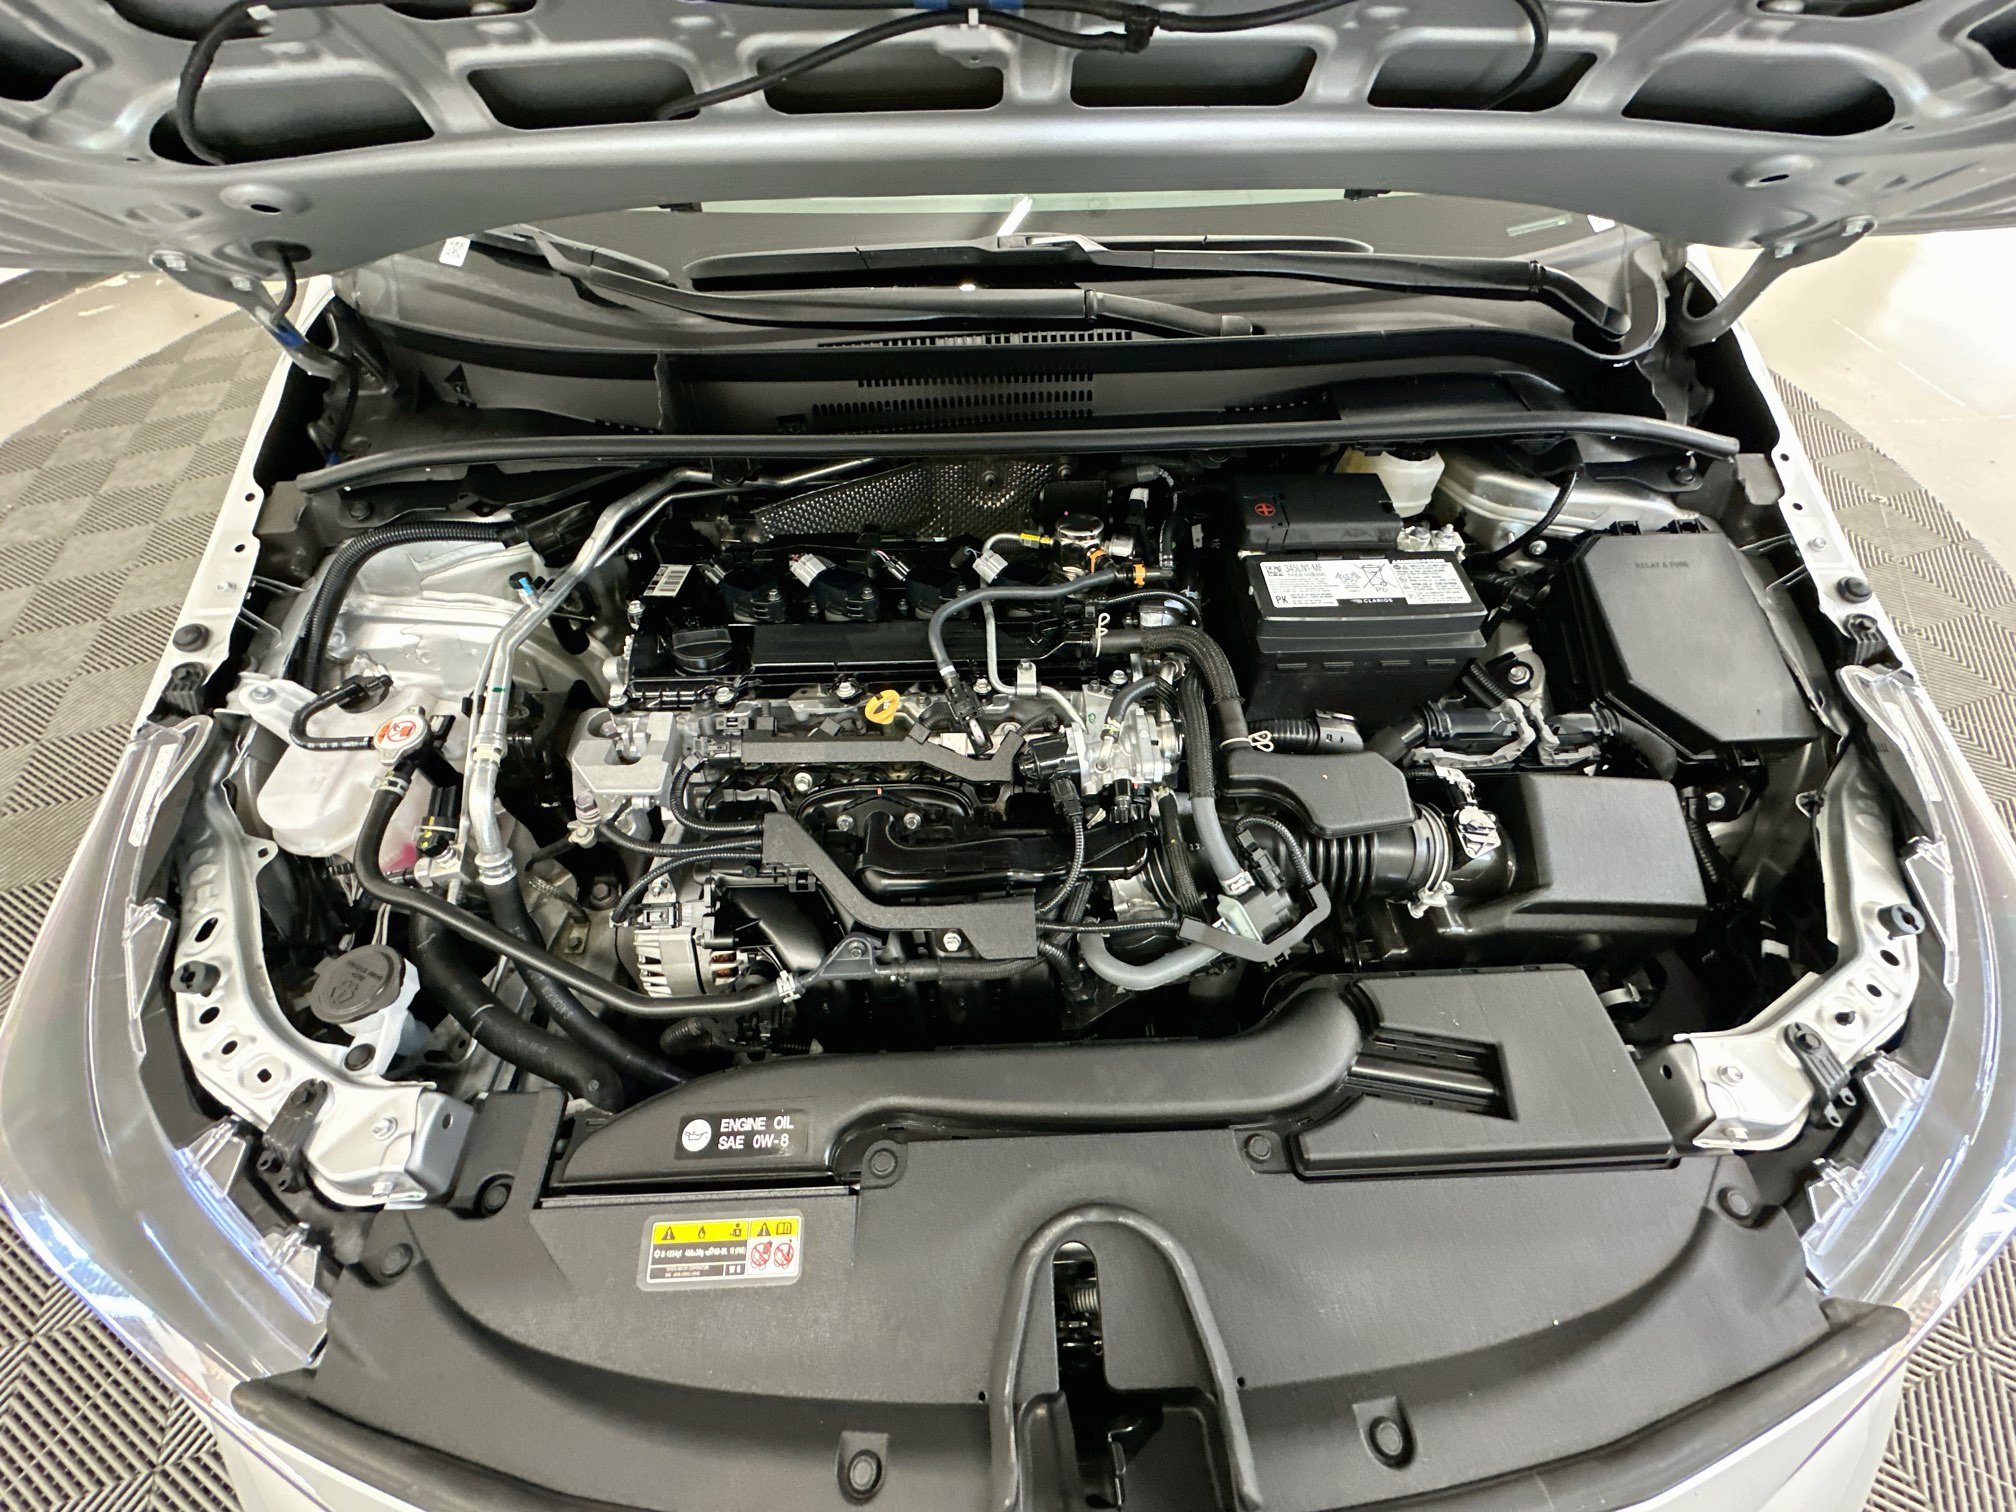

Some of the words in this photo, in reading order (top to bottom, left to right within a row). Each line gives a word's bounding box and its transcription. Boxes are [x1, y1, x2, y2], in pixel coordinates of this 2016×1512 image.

[1275, 595, 1289, 604] PK
[720, 1117, 766, 1132] ENGINE
[773, 1115, 794, 1129] OIL
[717, 1135, 745, 1150] SAE
[752, 1133, 790, 1149] 0W-8
